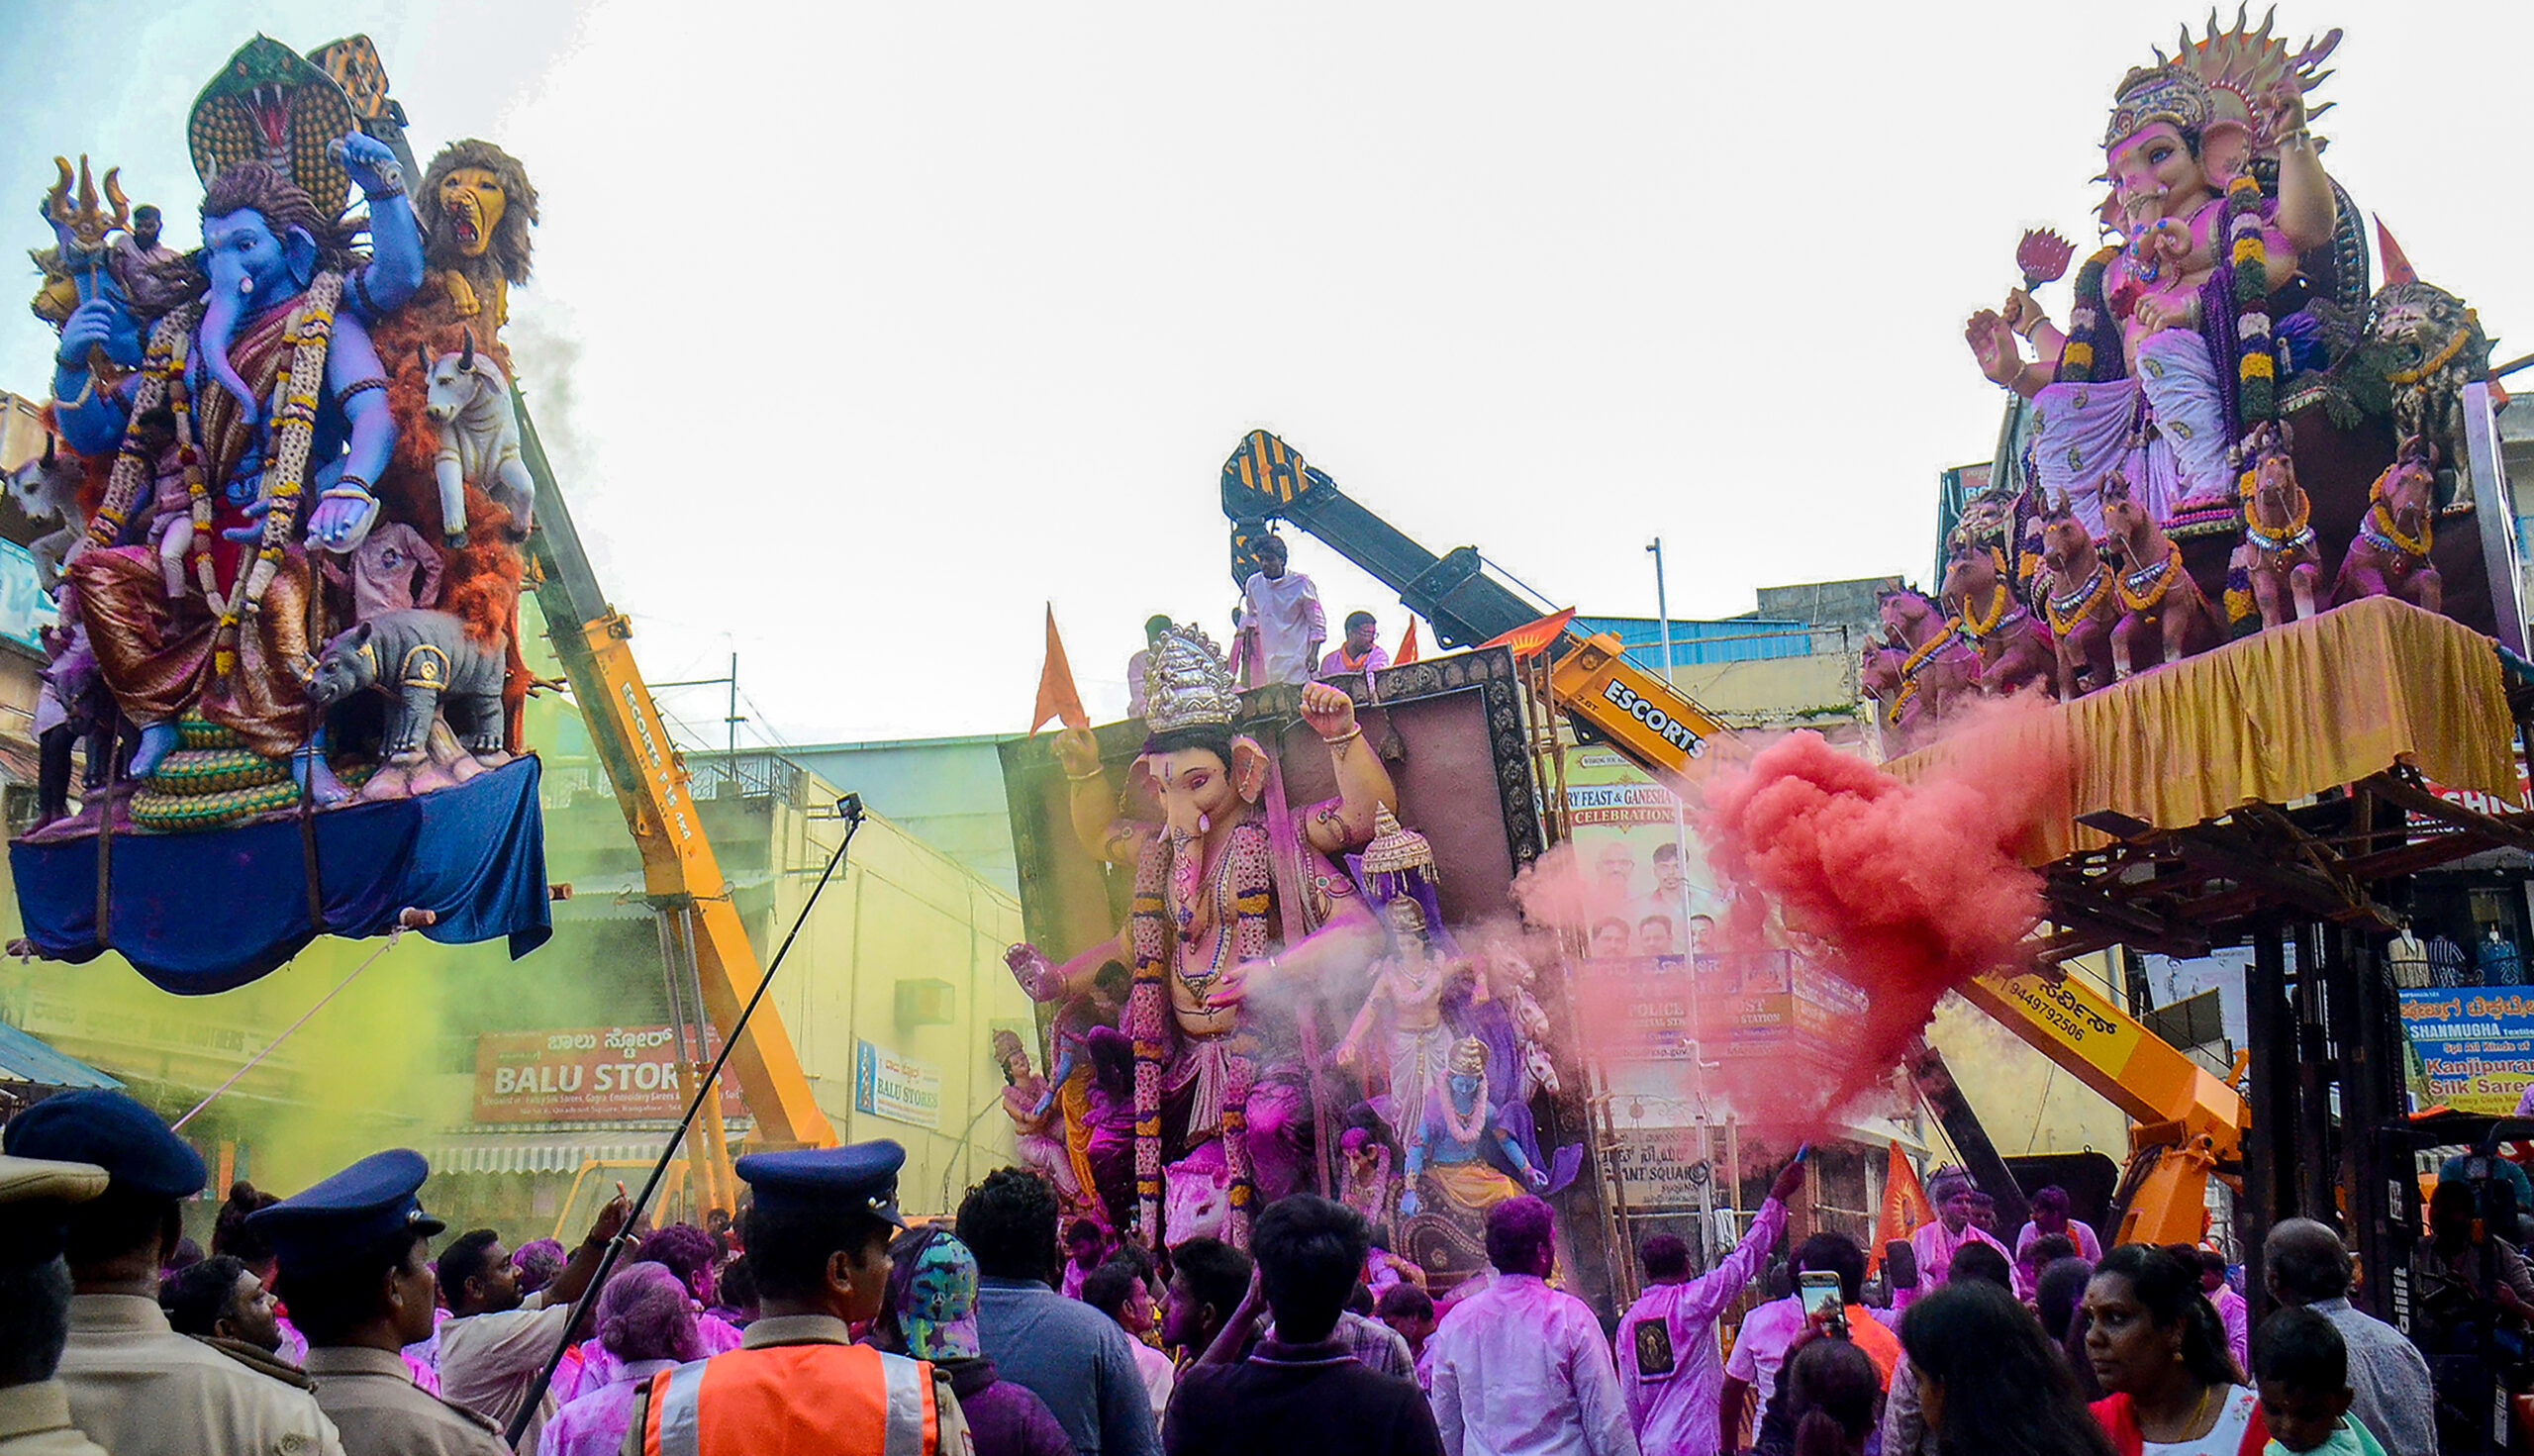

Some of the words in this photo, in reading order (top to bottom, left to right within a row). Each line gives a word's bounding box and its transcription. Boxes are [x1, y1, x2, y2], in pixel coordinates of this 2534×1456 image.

[621, 681, 661, 769] ESCORTS
[1603, 678, 1709, 759] ESCORTS
[1583, 790, 1612, 807] FEAST
[1613, 793, 1622, 803] &
[1624, 788, 1672, 806] GANESHA
[1741, 1013, 1781, 1024] STATION
[2009, 982, 2086, 1041] 9449792506
[2410, 1022, 2501, 1038] SHANMUGHA
[2482, 1040, 2515, 1052] Kinds
[2517, 1040, 2531, 1051] of
[495, 1064, 583, 1094] BALU
[2429, 1078, 2471, 1096] Silk
[877, 1077, 902, 1100] BALU
[903, 1087, 938, 1109] STORES
[1649, 1167, 1692, 1182] SQUAR
[2392, 1266, 2410, 1335] ailift
